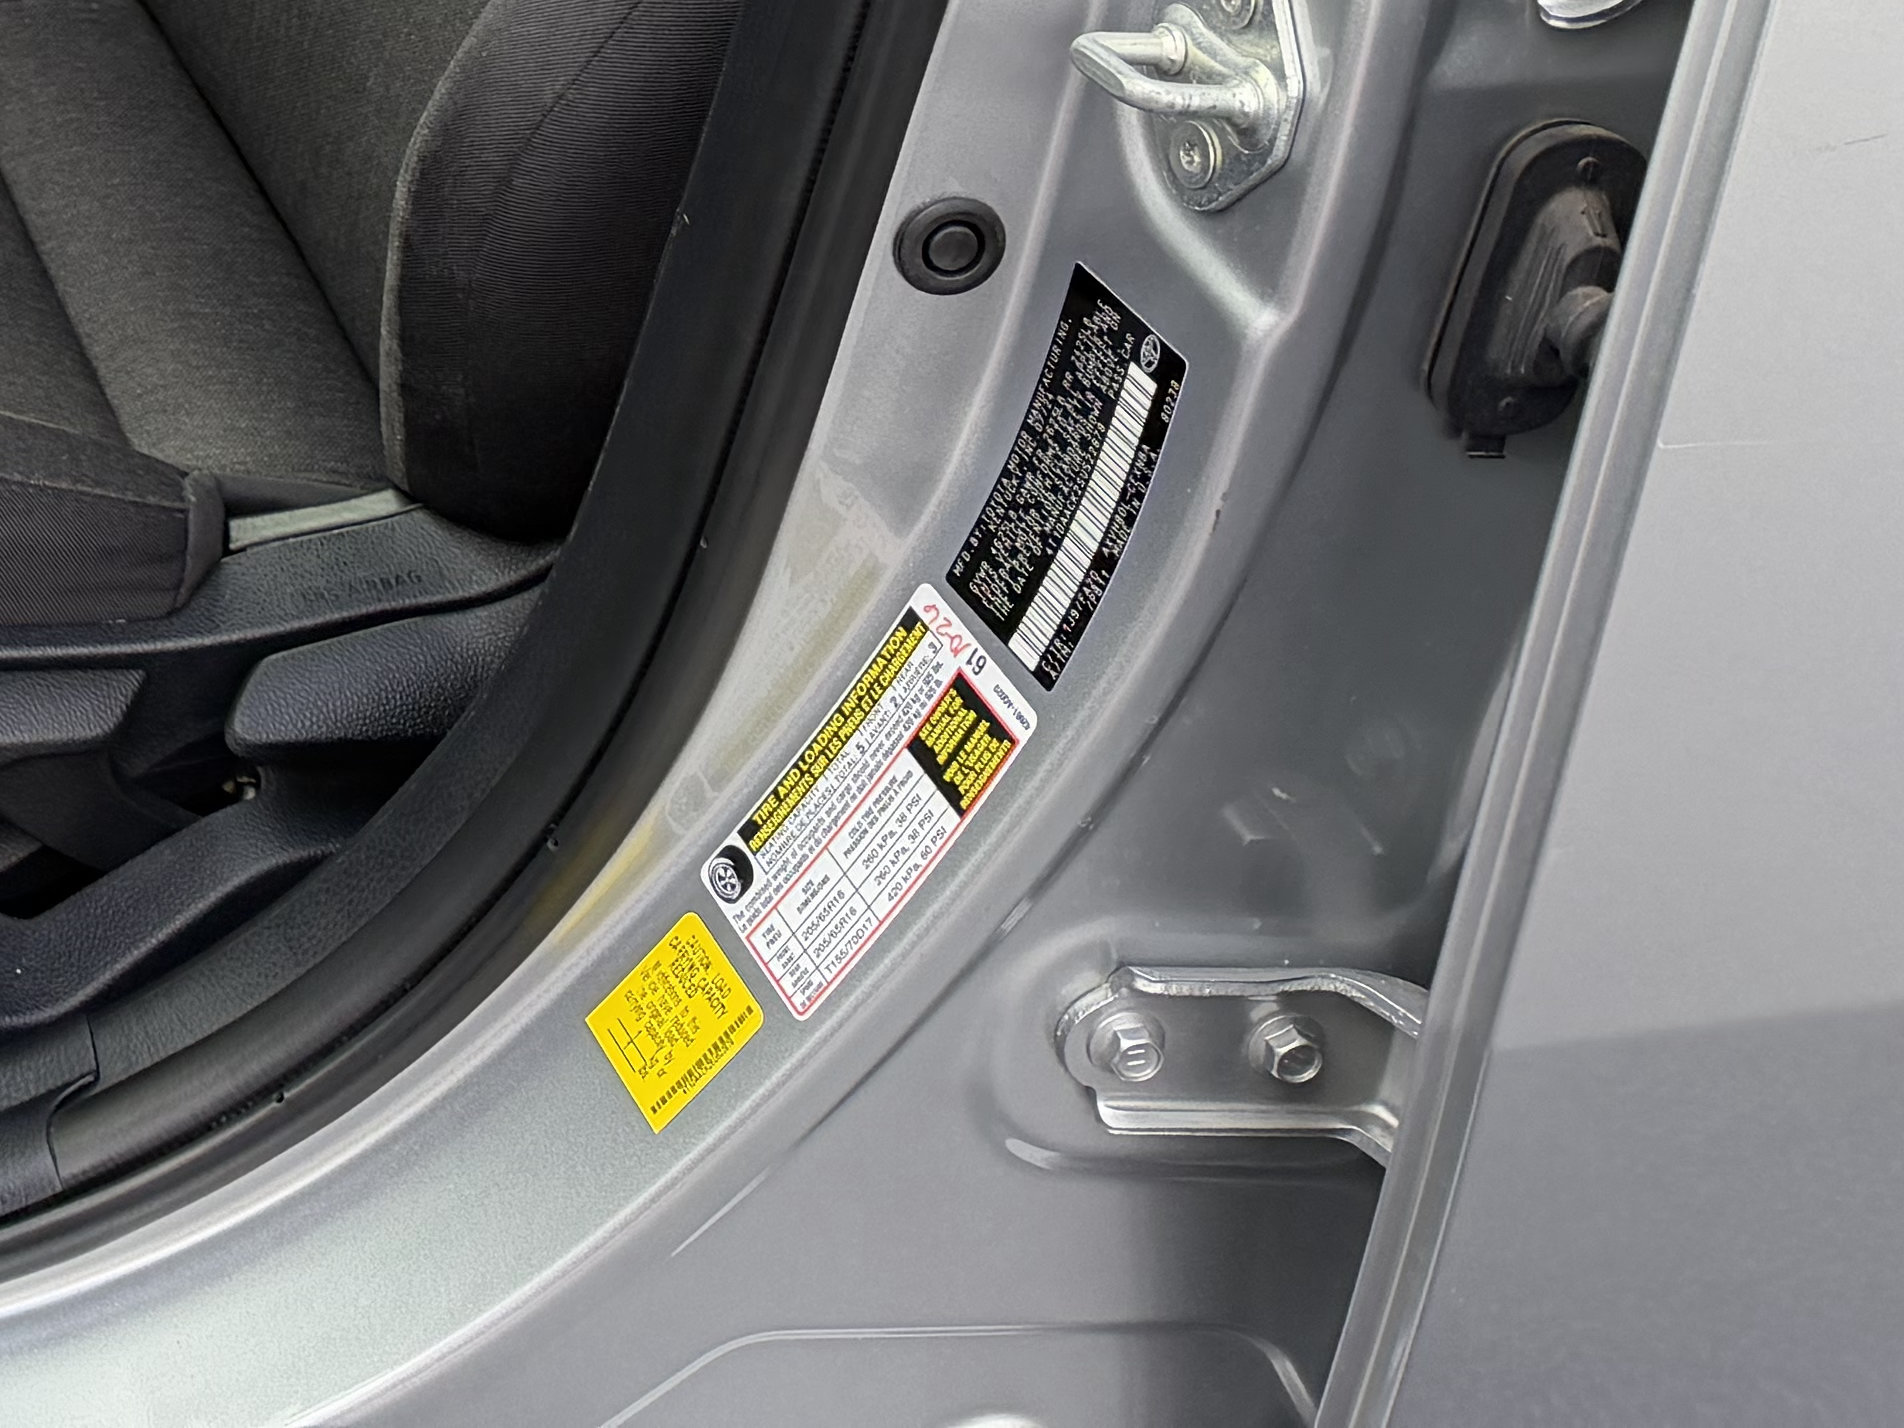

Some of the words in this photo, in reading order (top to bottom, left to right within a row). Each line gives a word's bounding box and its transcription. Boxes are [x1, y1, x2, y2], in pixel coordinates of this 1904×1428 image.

[1159, 377, 1181, 425] 80238
[1006, 427, 1030, 474] MOTOR
[1109, 519, 1131, 559] MADE
[1127, 495, 1141, 516] IN
[1135, 442, 1163, 495] U.S.A.
[1011, 556, 1034, 597] DATE
[1030, 535, 1045, 558] OF
[875, 620, 928, 688] CHARGEMENT
[927, 639, 939, 655] 3
[963, 645, 989, 678] 61
[859, 694, 874, 713] ET
[868, 679, 885, 700] LE
[888, 693, 901, 710] 2
[917, 720, 934, 742] SEE
[927, 686, 959, 726] OWNER'S
[751, 791, 780, 829] TIRE
[774, 764, 803, 801] AND
[796, 709, 845, 773] LOADING
[838, 624, 910, 717] INFORMATION
[836, 704, 866, 742] PNEUS
[923, 710, 953, 748] MANUAL
[947, 694, 964, 716] FOR
[930, 704, 970, 755] ADDITIONAL
[933, 707, 980, 767] INFORMATION
[809, 752, 830, 779] SUR
[823, 735, 843, 761] LES
[853, 739, 866, 756] 5
[940, 758, 961, 784] VOIR
[955, 748, 968, 764] LE
[962, 716, 992, 754] MANUEL
[956, 768, 979, 797] POUR
[973, 749, 992, 774] PLUS
[987, 736, 1001, 753] DE
[951, 769, 965, 786] DE
[747, 768, 815, 856] RENSEIGNEMENTS
[792, 818, 805, 835] DE
[799, 884, 846, 946] 205/65R16
[893, 809, 908, 829] 38
[904, 791, 922, 815] PSI
[811, 901, 858, 962] 205/65R16
[916, 807, 935, 831] PSI
[823, 912, 875, 979] T155/70D17
[884, 878, 904, 904] 420
[918, 842, 934, 862] 60
[929, 823, 948, 847] PSI
[667, 933, 701, 980] CARRYING
[694, 974, 729, 1021] CAPACITY
[667, 956, 700, 1000] REDUCED
[709, 971, 733, 1001] LOAD
